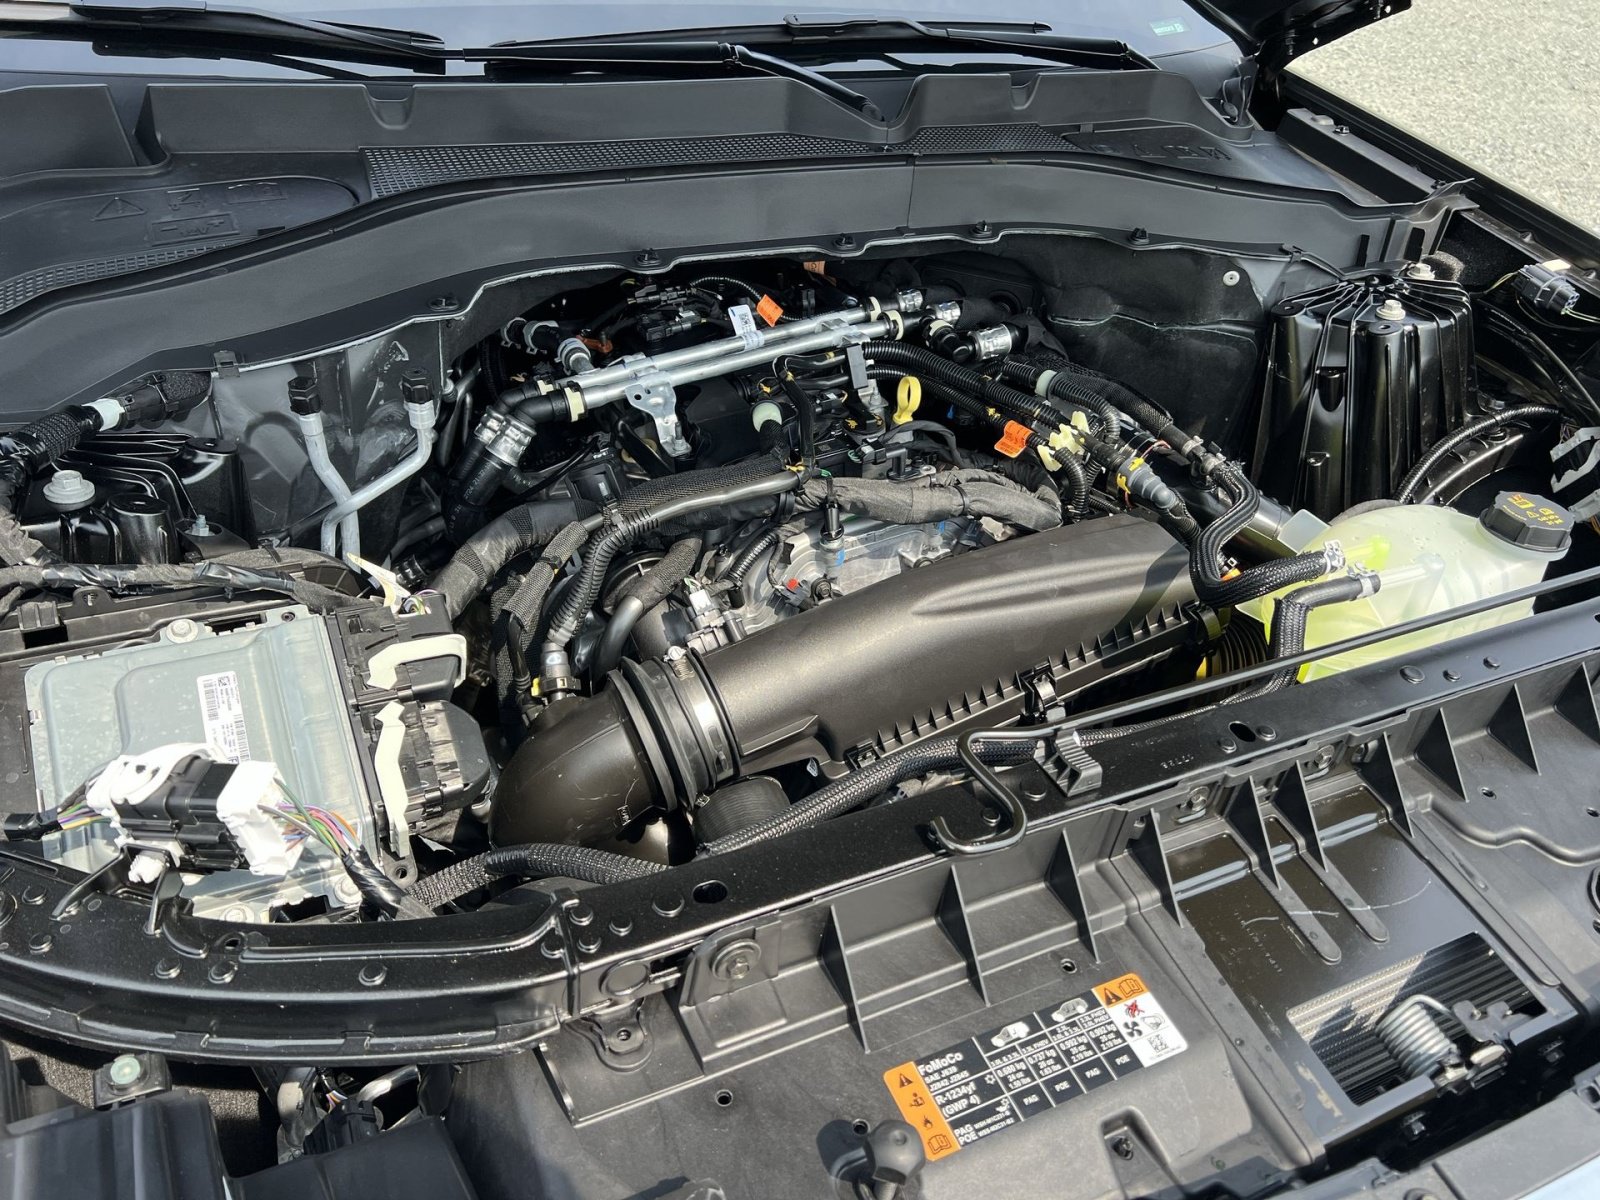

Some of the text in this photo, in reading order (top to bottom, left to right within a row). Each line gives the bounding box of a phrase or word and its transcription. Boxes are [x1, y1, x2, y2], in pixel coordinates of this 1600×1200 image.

[1105, 1020, 1116, 1030] kg
[1076, 1033, 1087, 1042] kg
[1027, 1048, 1056, 1064] 0.737 kg
[1115, 1054, 1130, 1065] POE
[917, 1050, 963, 1075] FoMoCo
[1015, 1060, 1026, 1069] kg
[923, 1071, 940, 1083] SAE
[1084, 1067, 1100, 1078] PAG
[1054, 1080, 1069, 1091] POE
[935, 1081, 976, 1105] R-1234yf
[1022, 1093, 1038, 1105] PAG
[942, 1093, 980, 1117] (GWP 4)
[953, 1123, 973, 1136] PAG
[958, 1131, 977, 1144] POE
